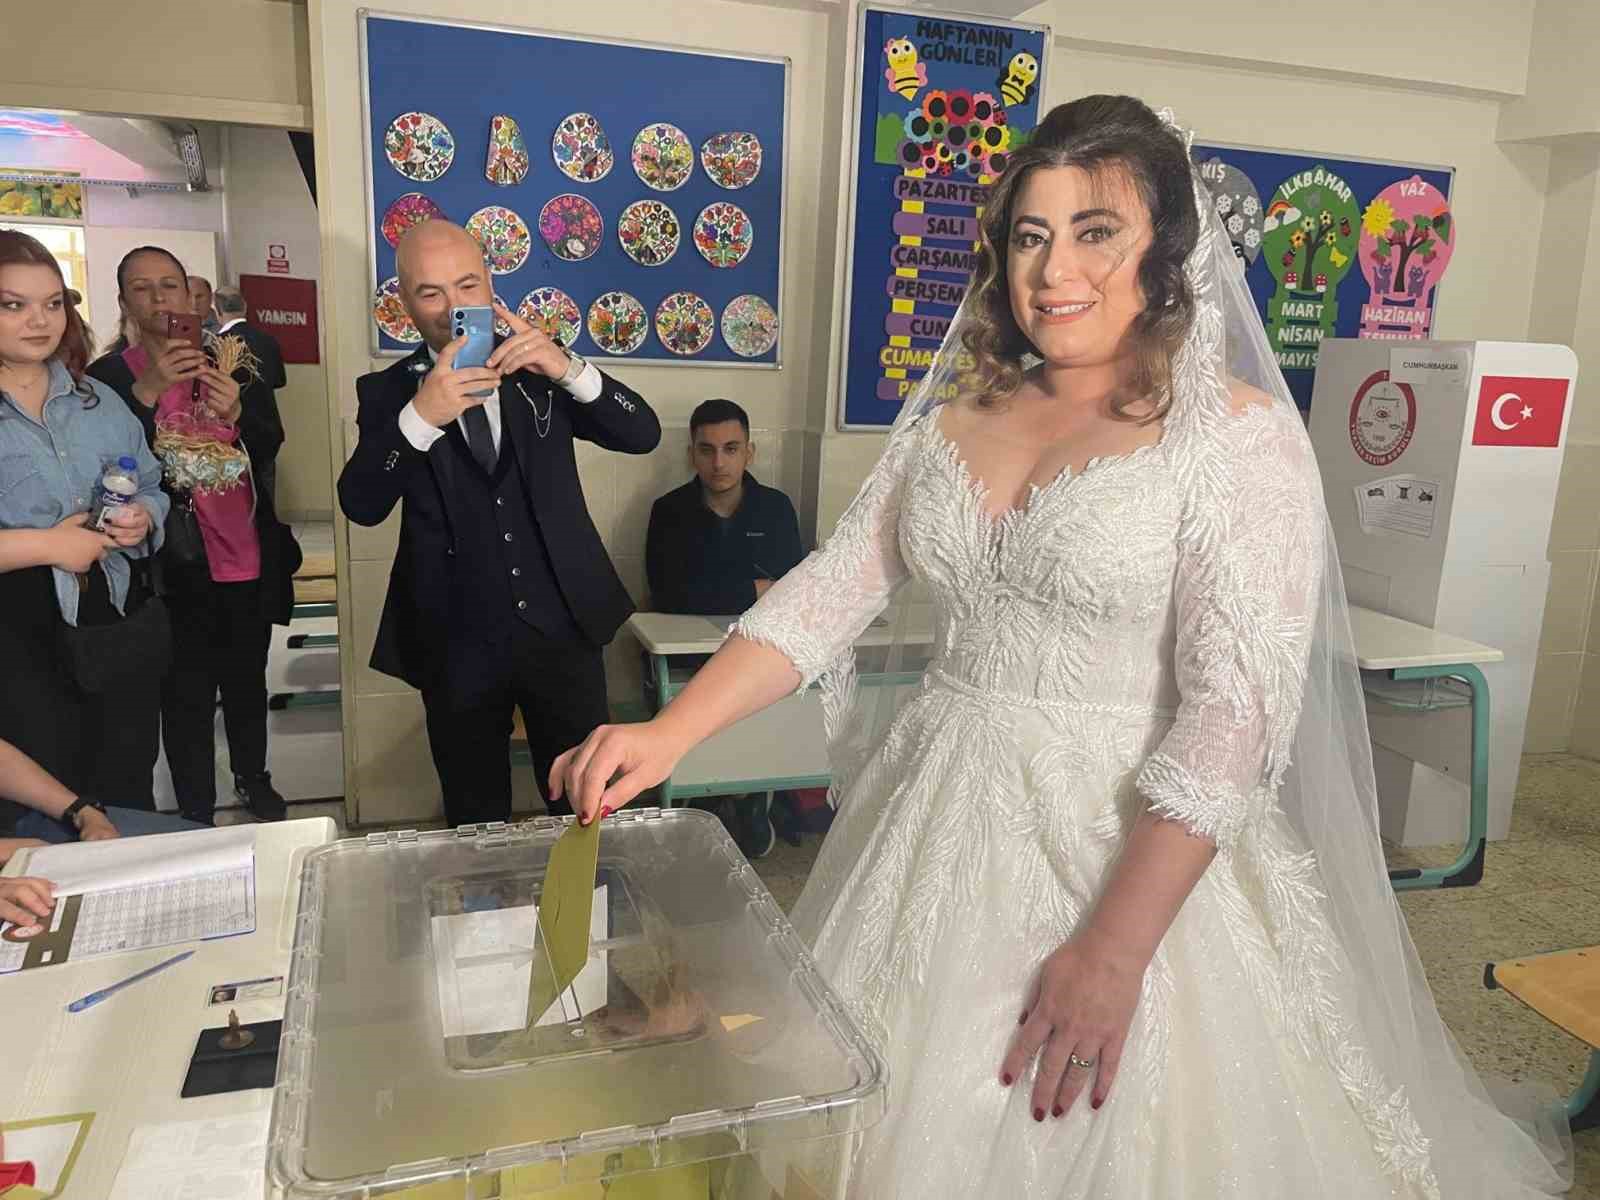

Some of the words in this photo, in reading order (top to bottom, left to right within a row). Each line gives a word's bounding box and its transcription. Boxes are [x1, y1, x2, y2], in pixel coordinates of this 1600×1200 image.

[898, 180, 989, 203] PAZARTES
[1400, 182, 1426, 197] YAZ
[927, 217, 965, 236] SALI
[894, 247, 980, 271] ÇARŞAMB
[895, 281, 961, 303] PERŞEM
[256, 309, 308, 326] YANGIN
[1281, 302, 1324, 318] MART
[1364, 307, 1426, 324] HAZİRAN
[910, 319, 953, 337] CUM
[1277, 325, 1324, 342] NİSAN
